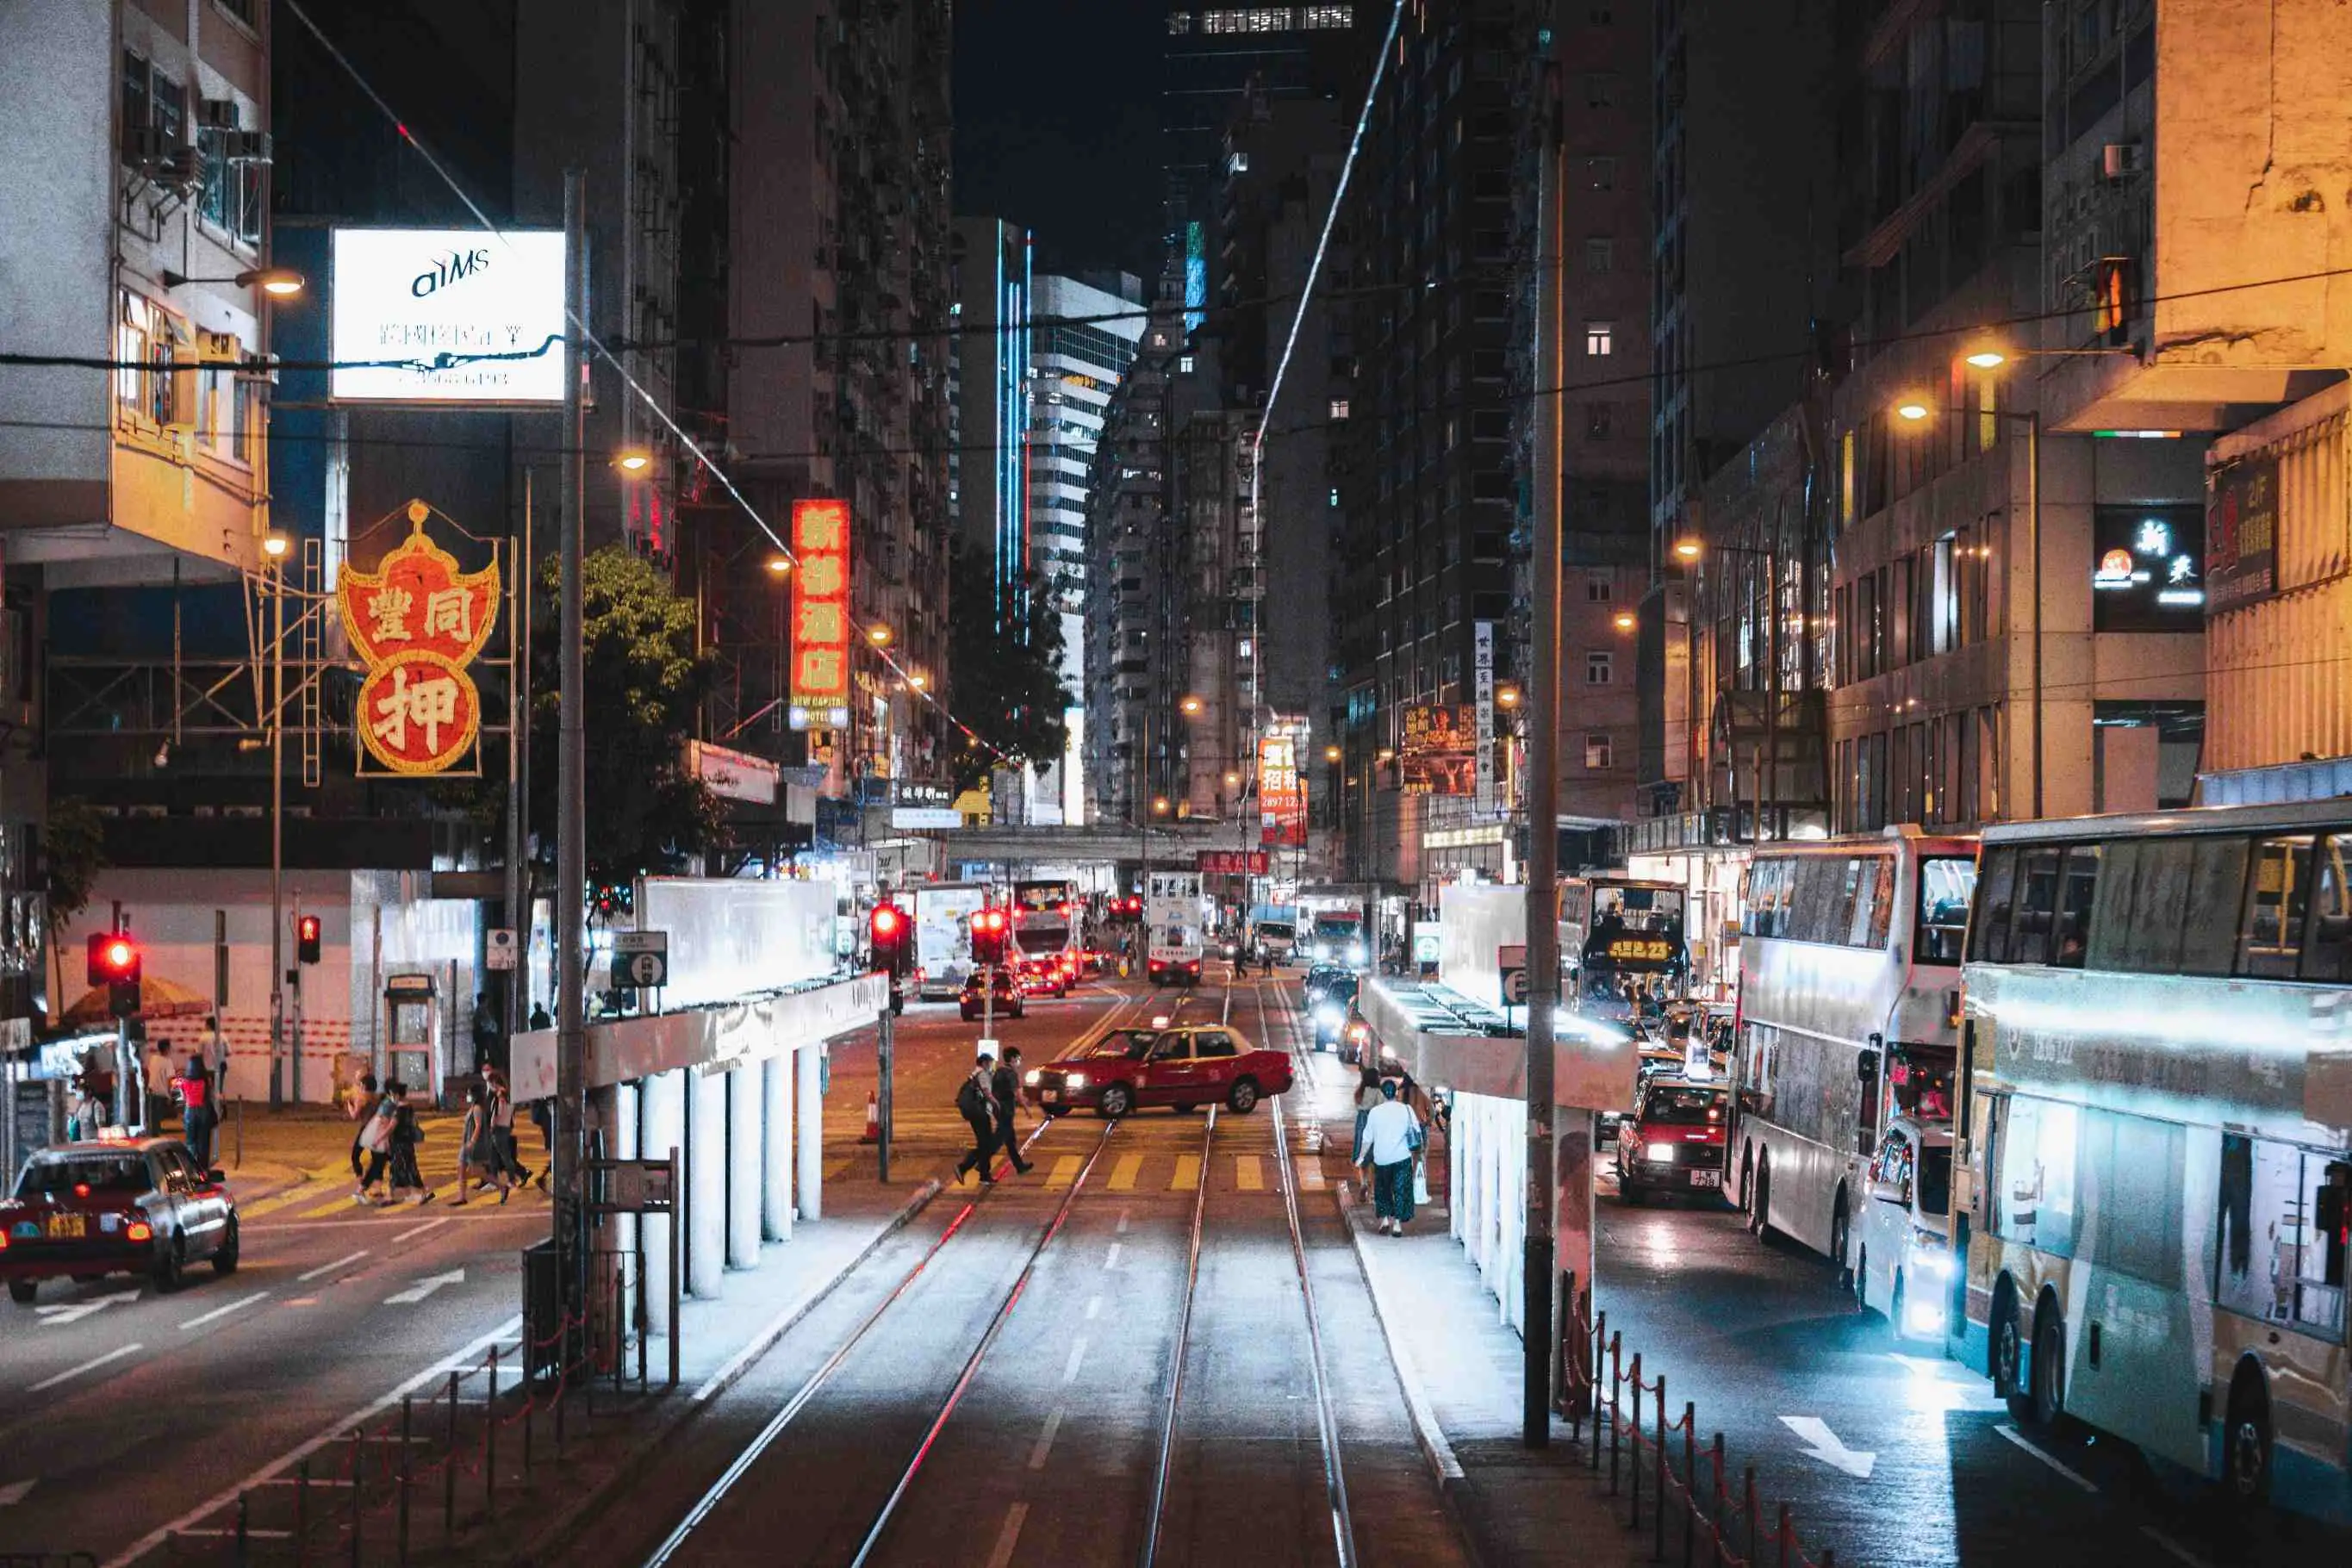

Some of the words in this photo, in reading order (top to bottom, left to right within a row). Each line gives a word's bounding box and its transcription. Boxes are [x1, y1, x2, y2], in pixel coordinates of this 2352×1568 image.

[800, 507, 842, 689] 新都酒店
[373, 665, 459, 756] 押
[793, 695, 810, 706] NEW
[812, 695, 846, 706] CAPITAL
